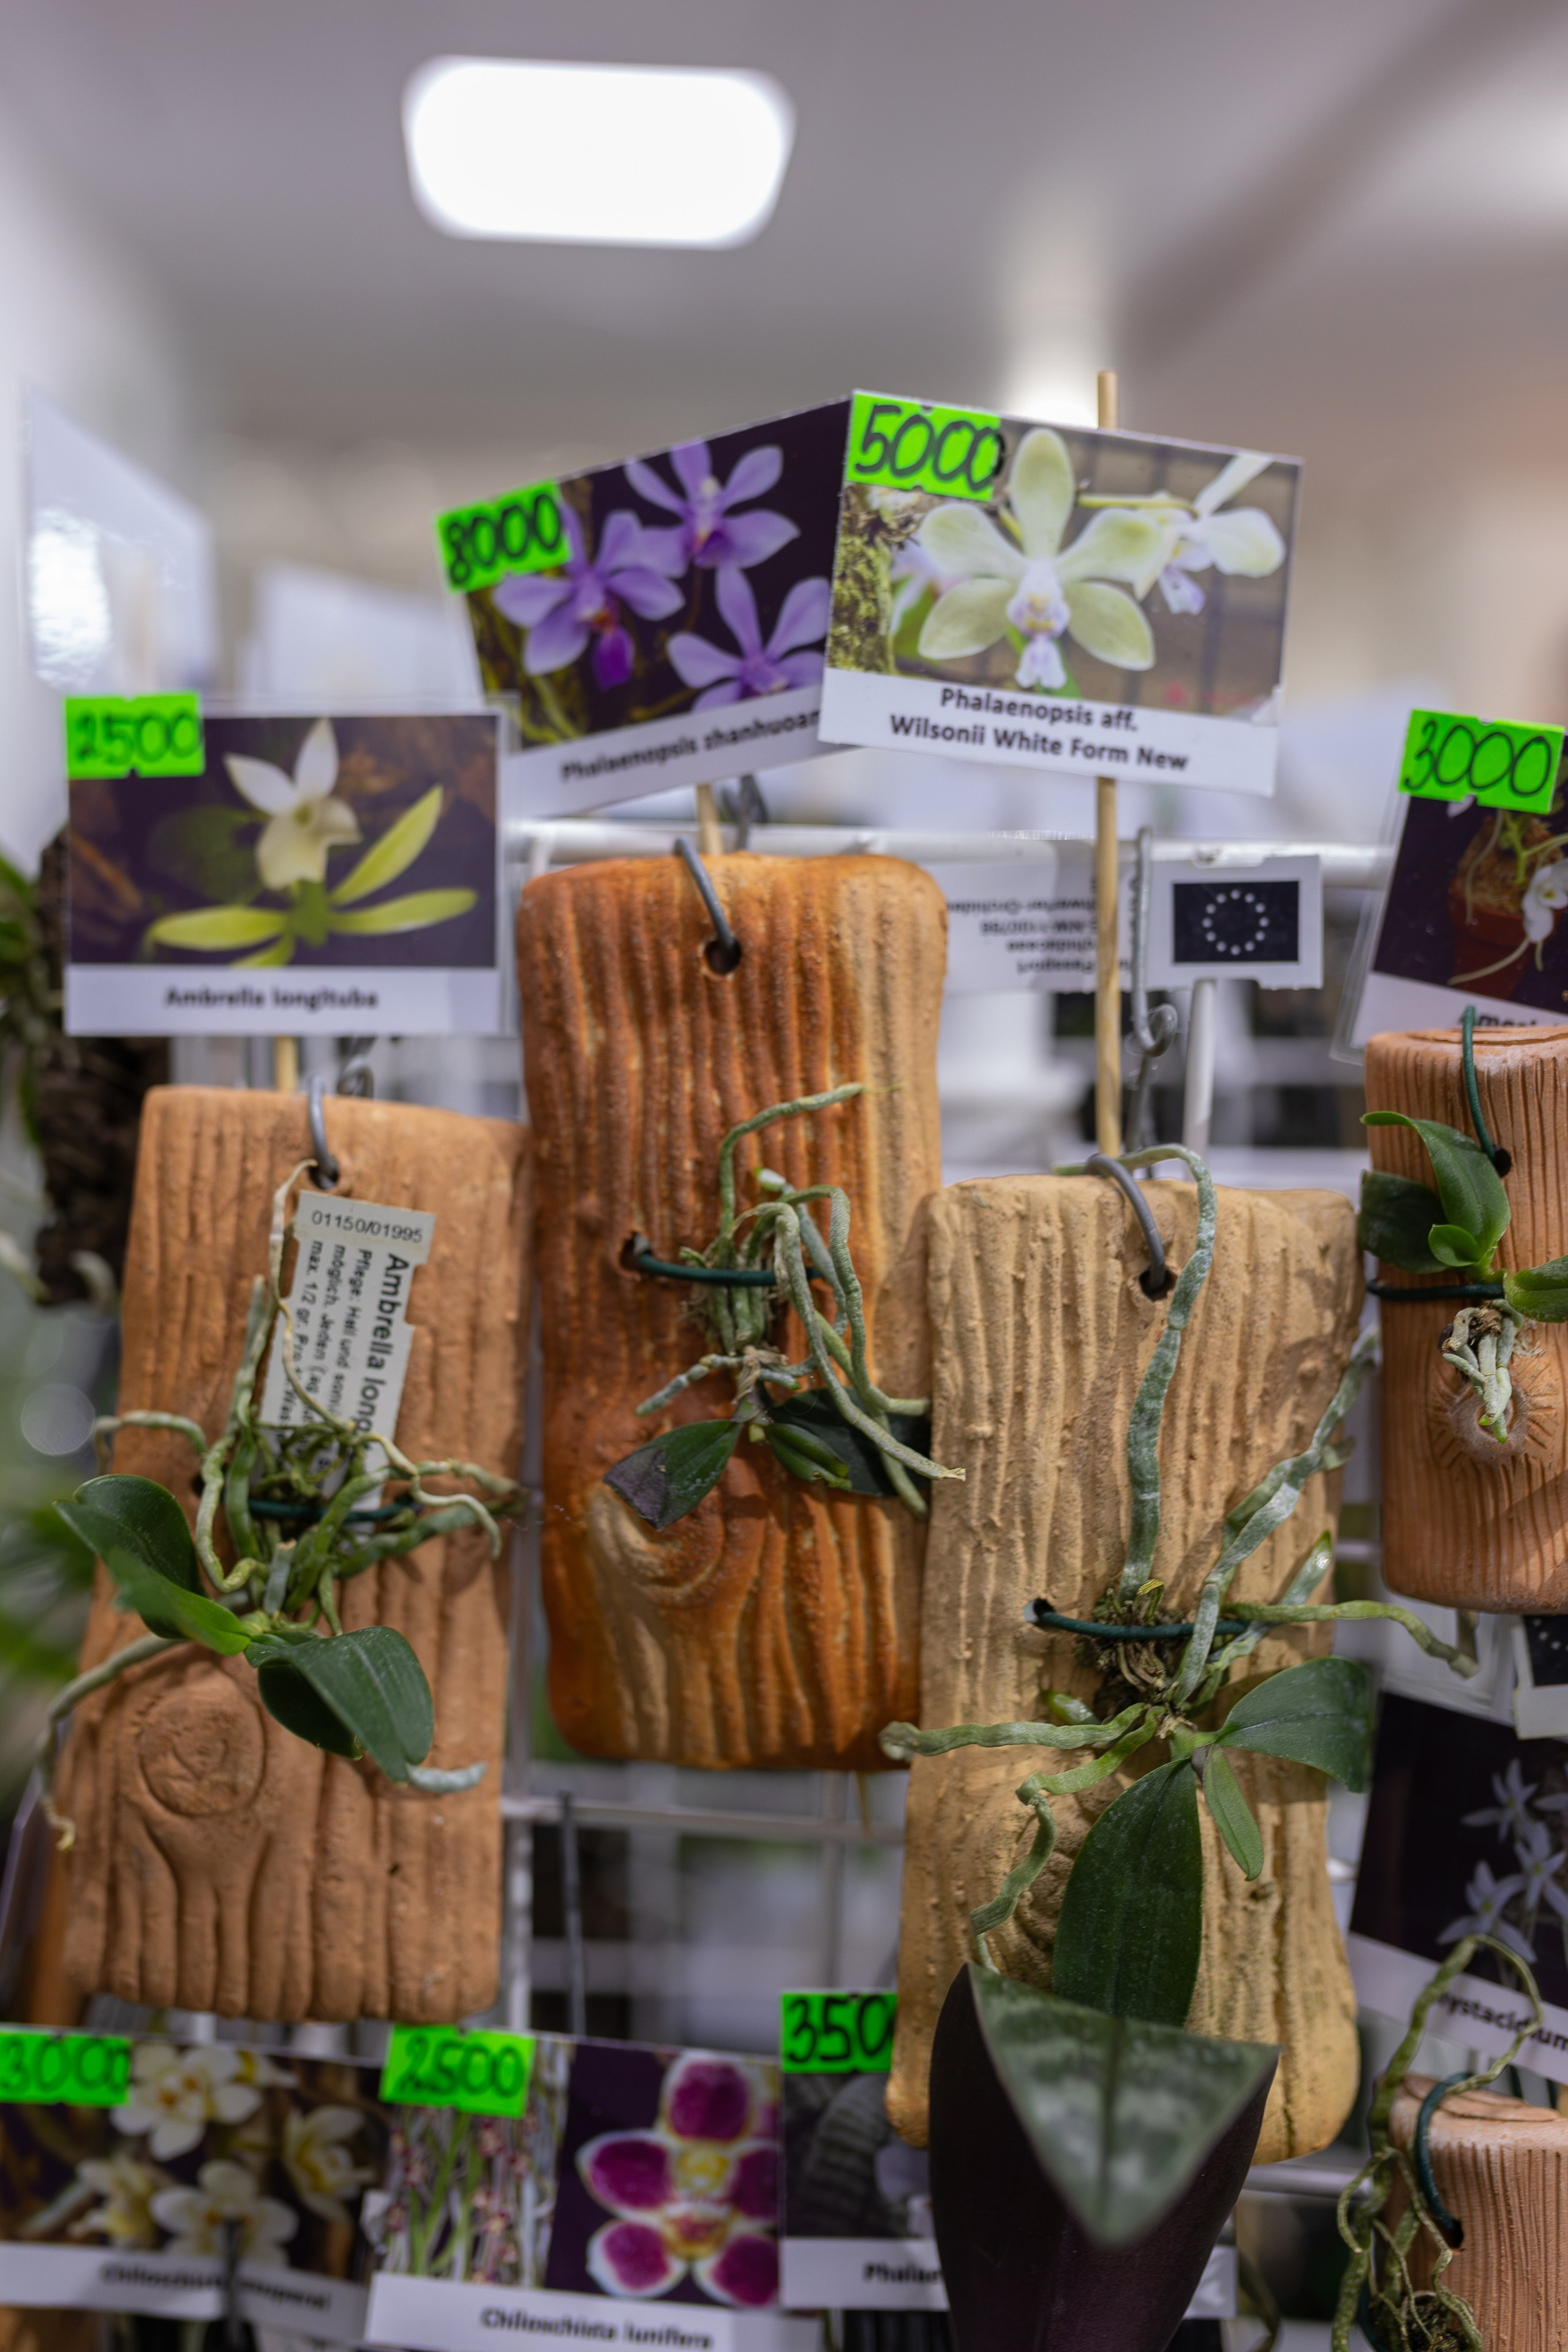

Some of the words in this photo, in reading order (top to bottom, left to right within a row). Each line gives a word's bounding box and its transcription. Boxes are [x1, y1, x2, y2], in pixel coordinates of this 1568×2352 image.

[856, 404, 1006, 492] 5000
[447, 493, 562, 585] 8000
[941, 687, 1093, 726] Phalaenopsis
[1102, 709, 1137, 731] aff.
[890, 714, 985, 745] Wilsonii
[993, 728, 1062, 756] White
[1070, 738, 1129, 764] Form
[1138, 747, 1188, 772] New
[1404, 720, 1553, 796] 3000
[311, 1209, 423, 1244] 01150/01995
[306, 1240, 323, 1274] max.
[347, 1248, 372, 1303] Pflege:
[366, 1253, 409, 1371] Ambrella
[786, 1994, 897, 2063] 350
[1437, 1993, 1568, 2052] ystacidum
[396, 2035, 526, 2097] 2500
